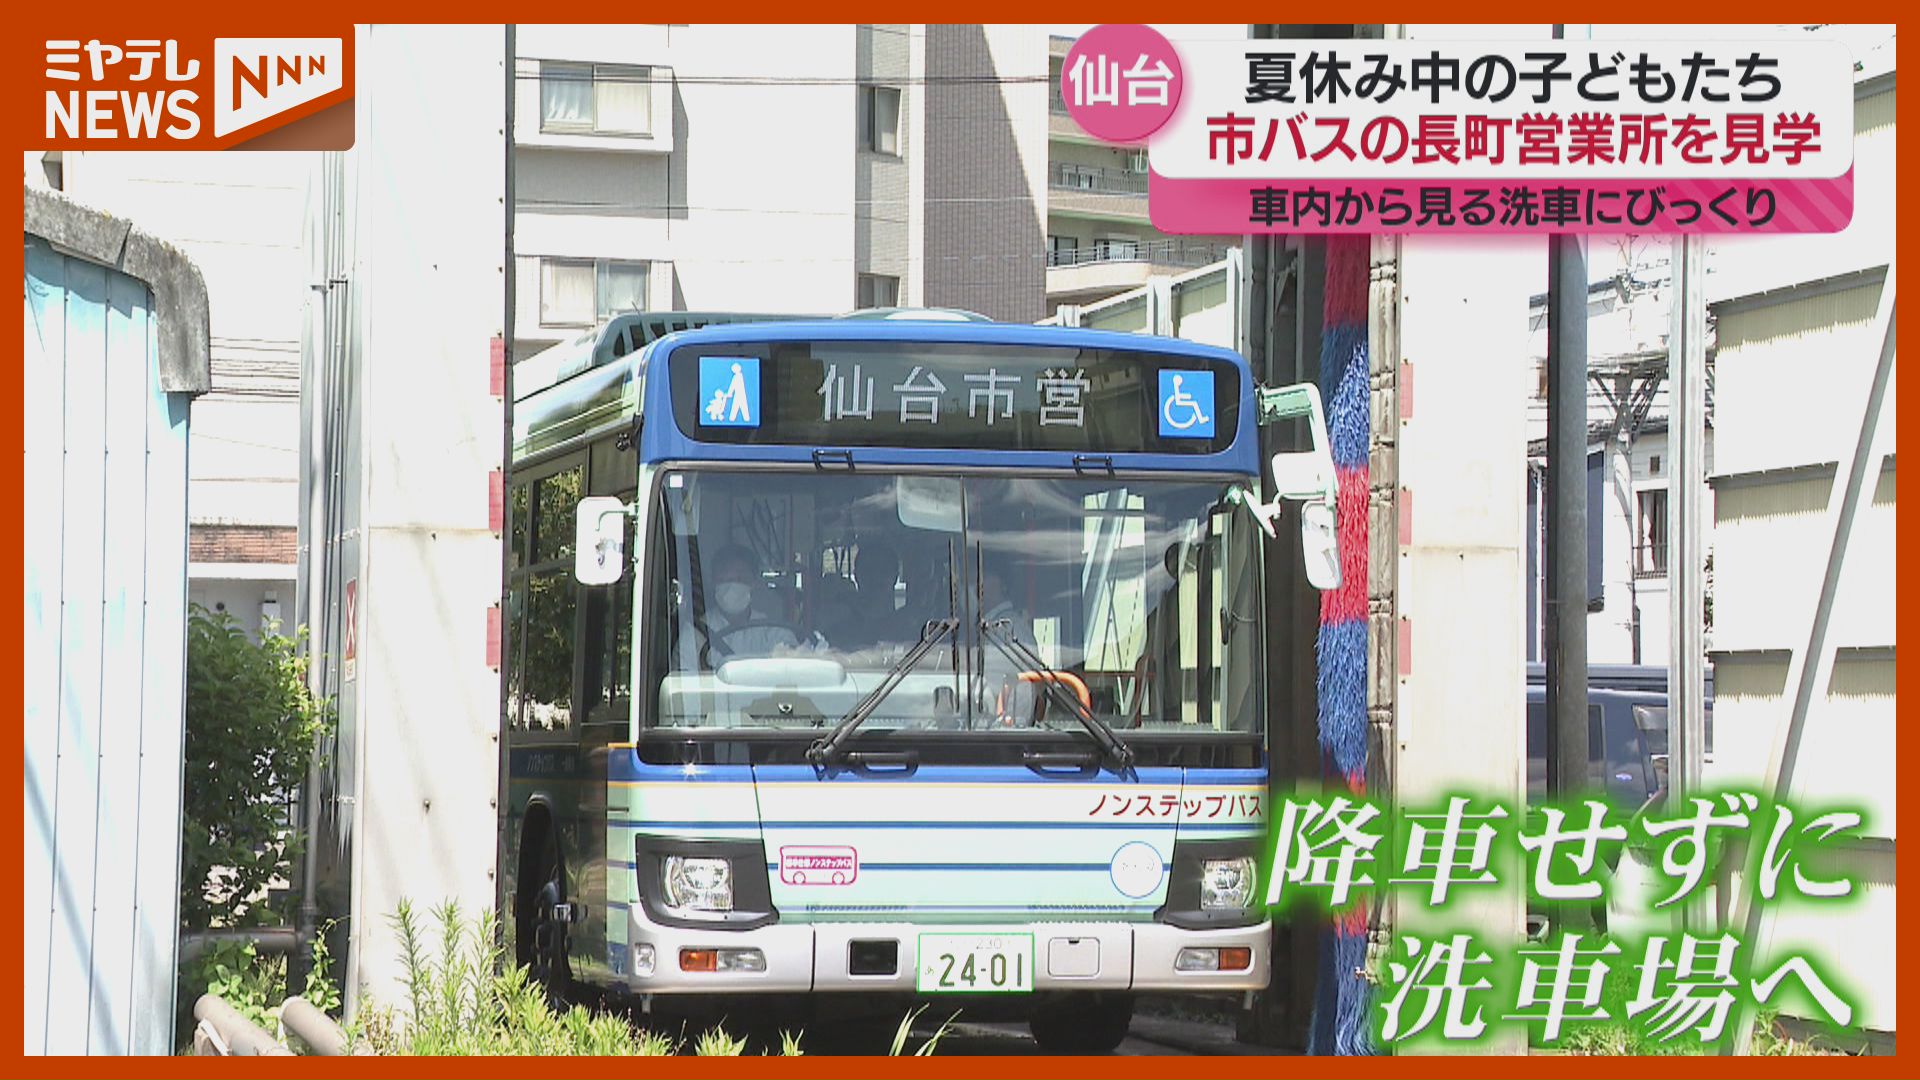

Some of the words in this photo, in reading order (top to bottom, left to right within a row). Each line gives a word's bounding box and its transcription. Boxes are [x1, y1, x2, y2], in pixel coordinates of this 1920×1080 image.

[817, 363, 1091, 427] 仙台市営
[1088, 794, 1263, 818] ノンステップバス
[938, 952, 1023, 988] 24-01
